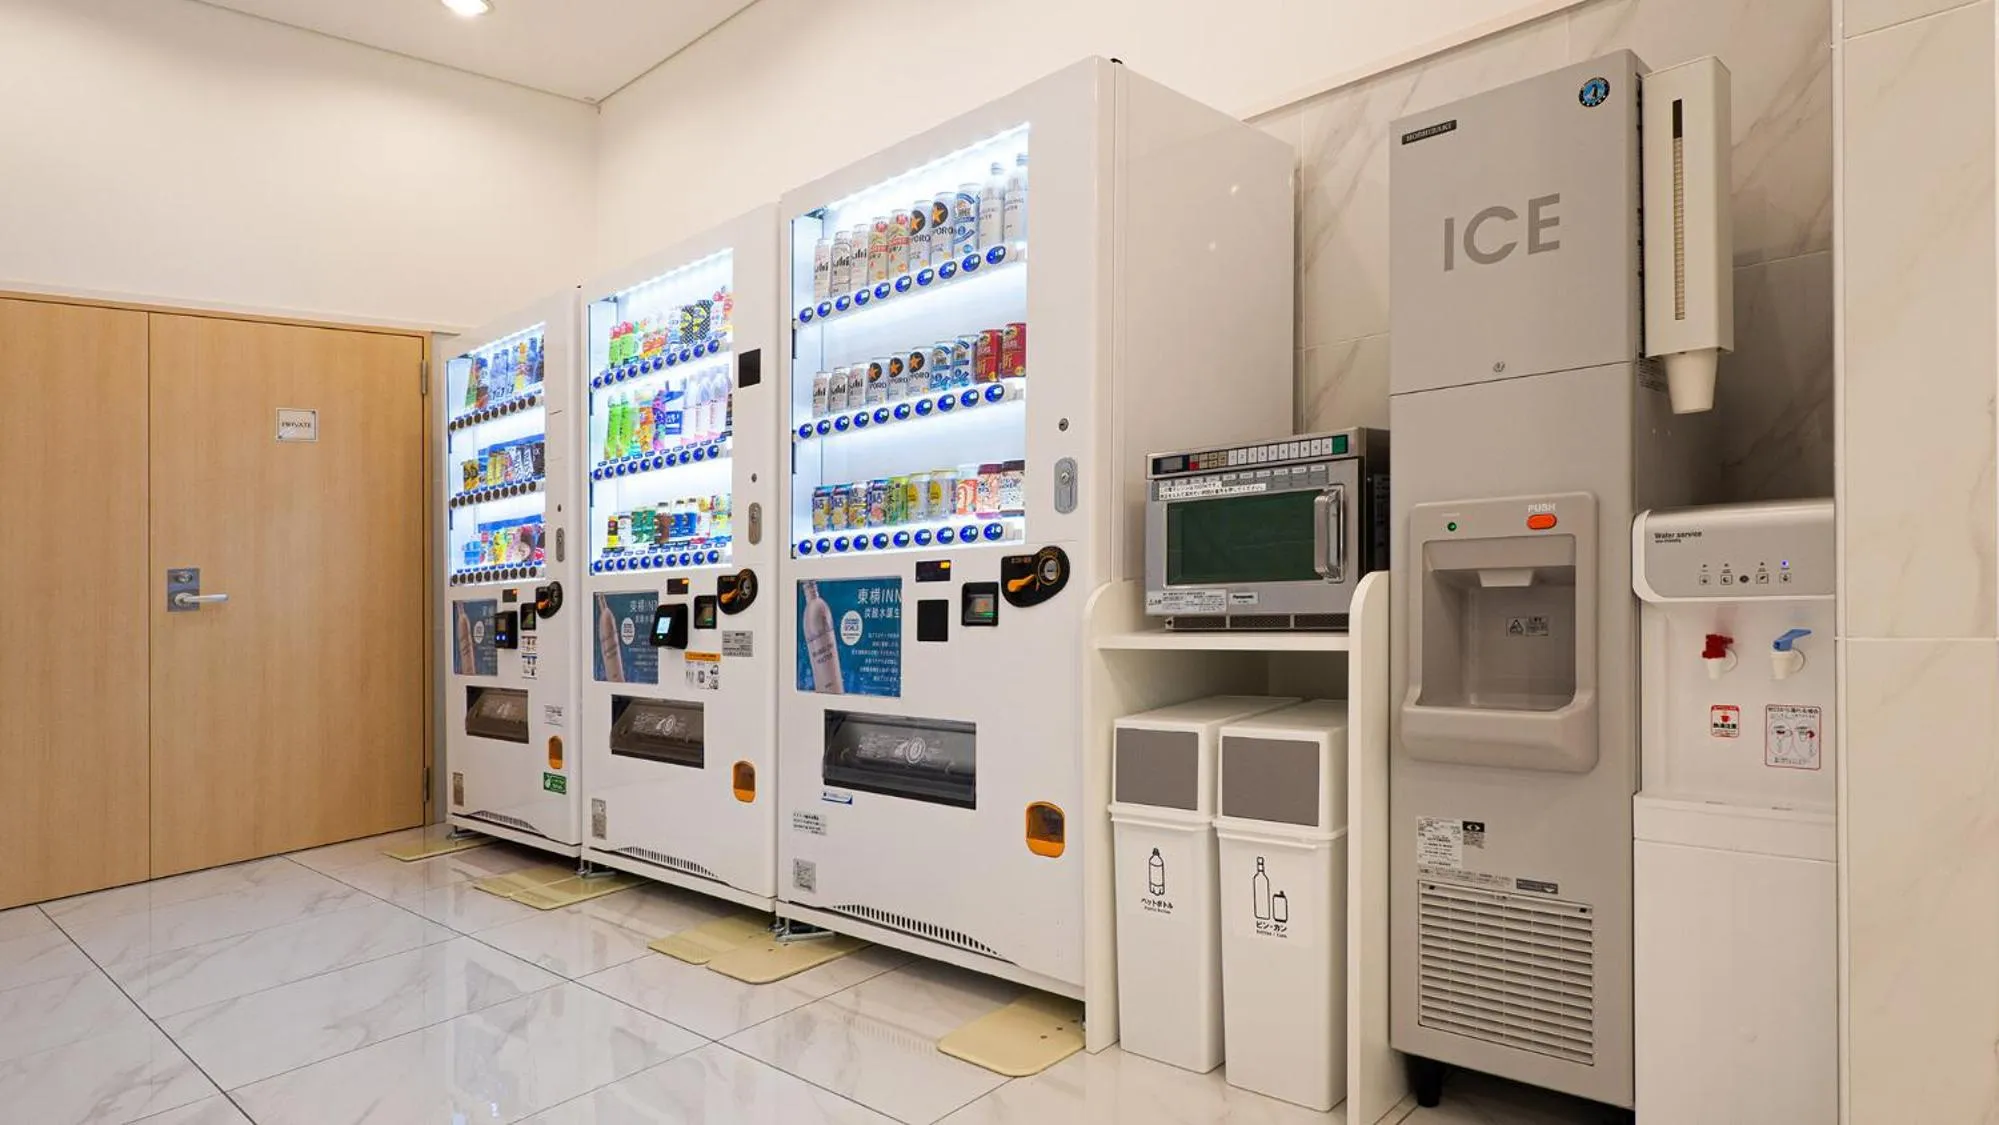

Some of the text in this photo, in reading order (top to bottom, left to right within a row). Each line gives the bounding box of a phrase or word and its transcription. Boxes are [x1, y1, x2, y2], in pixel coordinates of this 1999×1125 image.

[1443, 192, 1560, 272] ICE
[1528, 502, 1557, 513] PUSH
[1654, 531, 1702, 540] Water service
